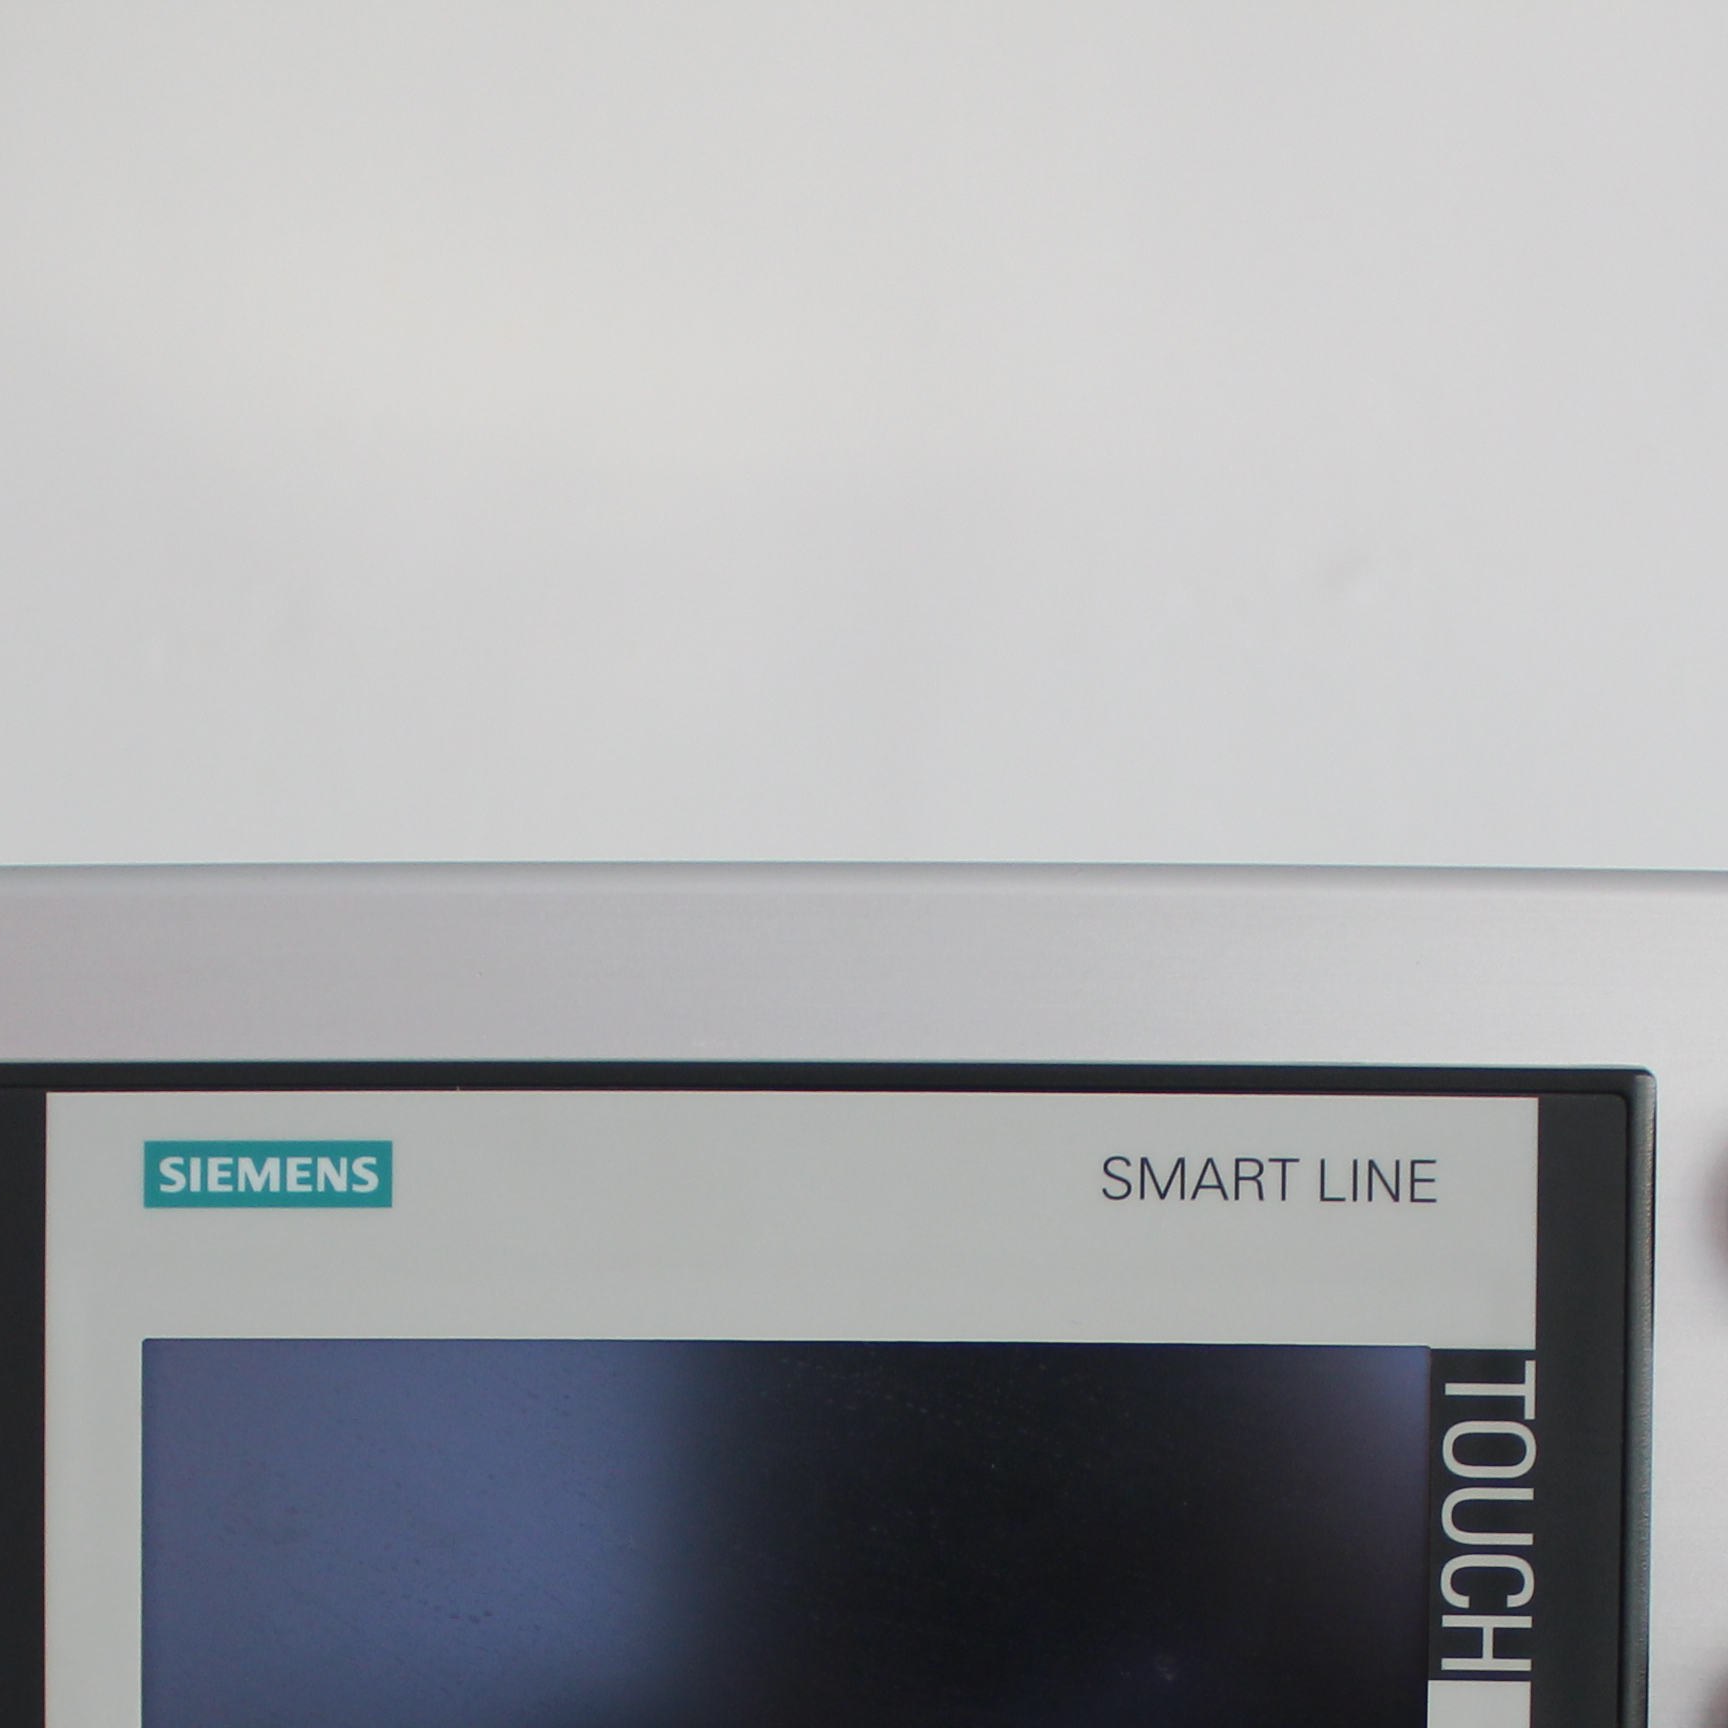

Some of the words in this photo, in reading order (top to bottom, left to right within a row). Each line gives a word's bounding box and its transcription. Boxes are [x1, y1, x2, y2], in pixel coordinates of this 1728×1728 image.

[158, 1155, 380, 1194] SIEMENS
[1101, 1155, 1301, 1202] SMART
[1319, 1157, 1438, 1203] LINE
[1439, 1359, 1538, 1672] TOUCH
